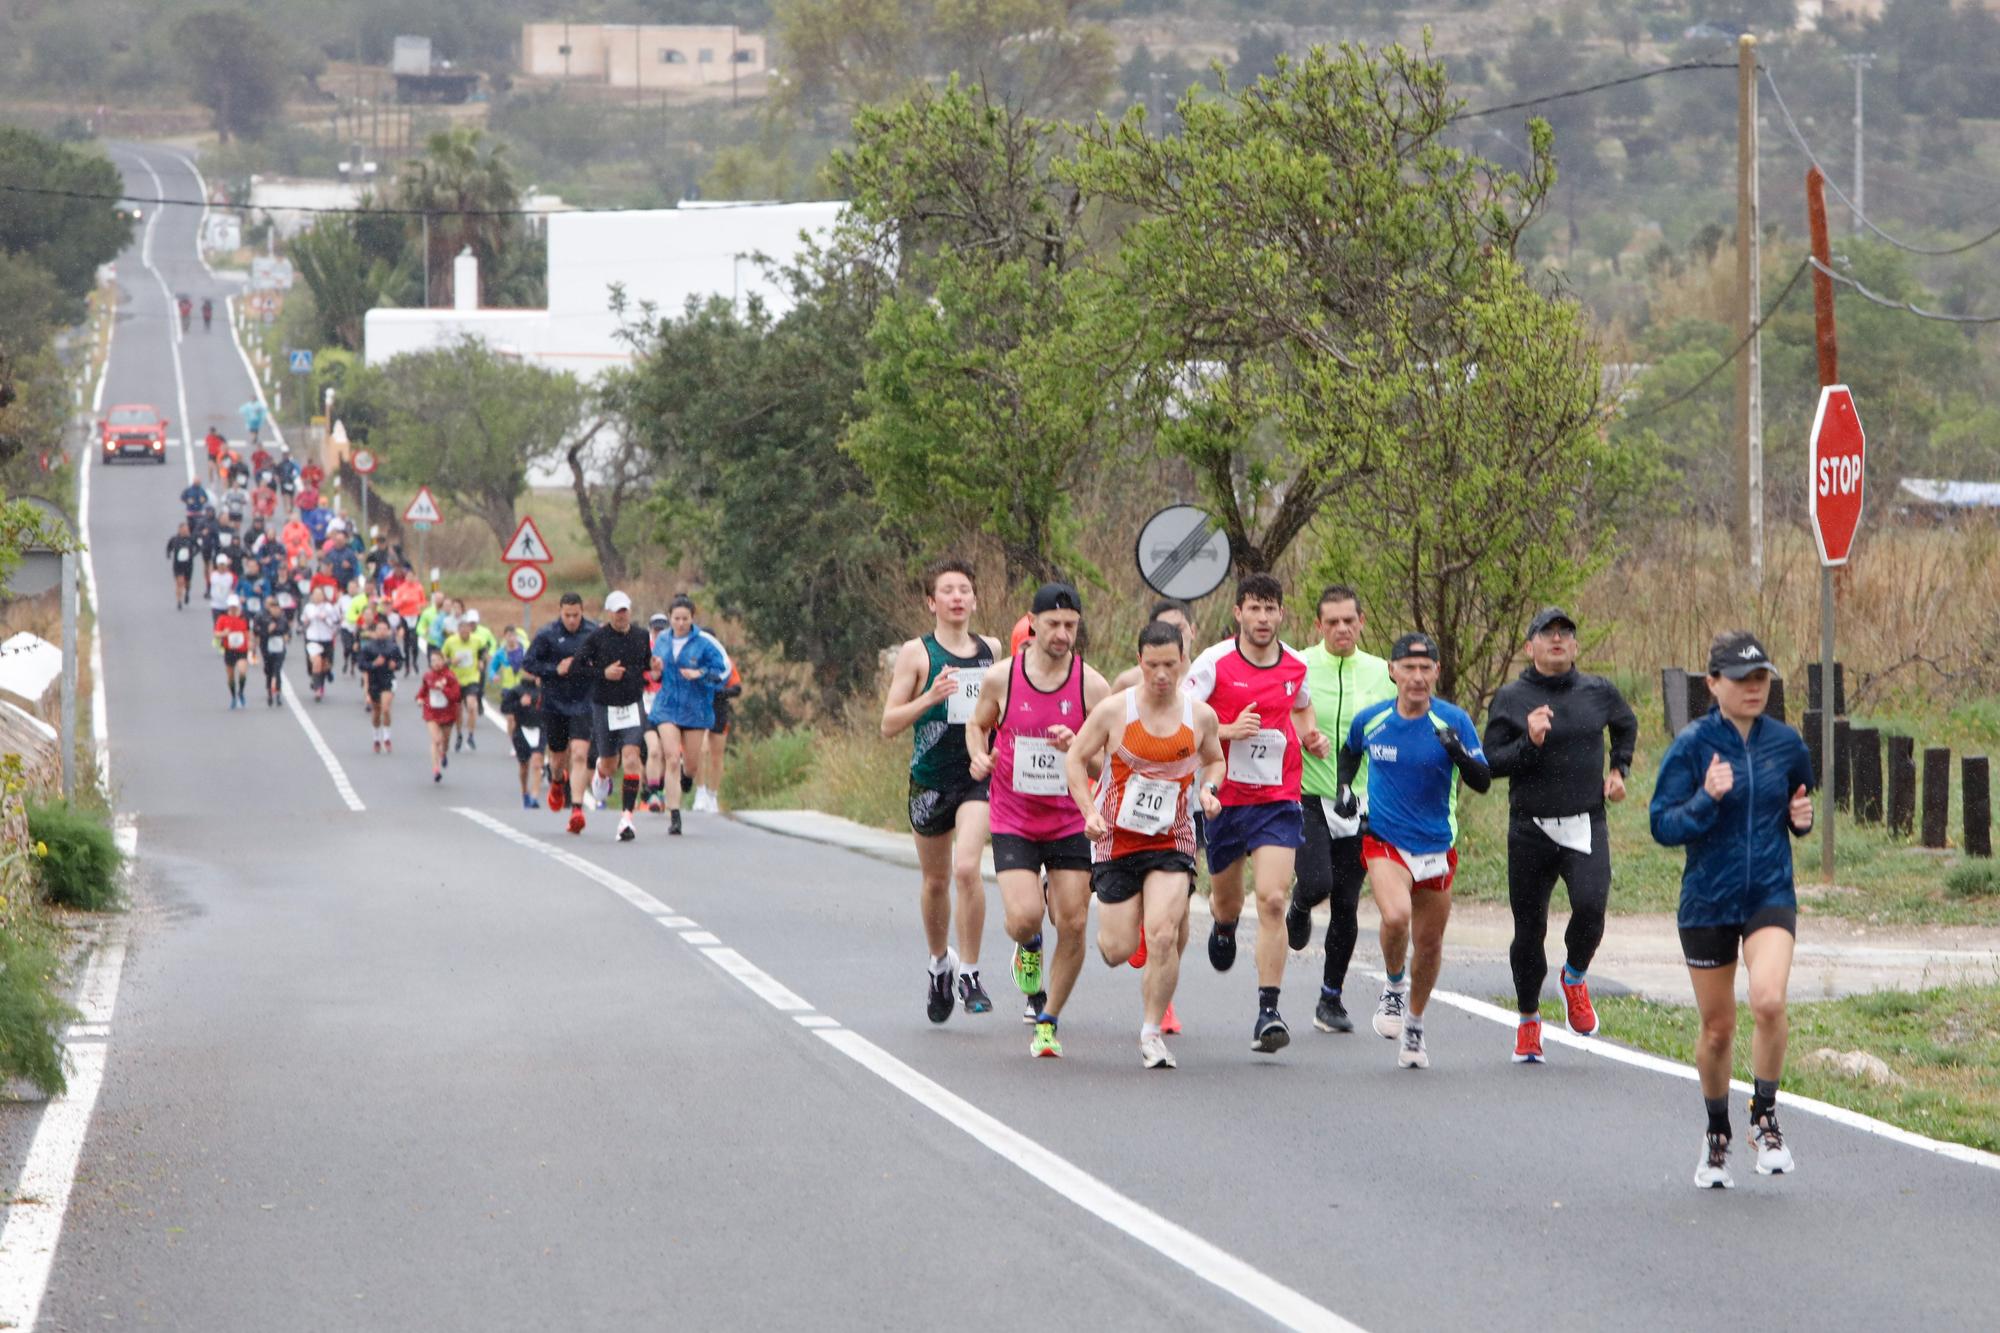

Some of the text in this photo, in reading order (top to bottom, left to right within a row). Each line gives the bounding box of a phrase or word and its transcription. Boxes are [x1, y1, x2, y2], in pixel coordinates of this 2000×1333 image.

[1819, 454, 1861, 497] STOP
[517, 576, 538, 589] 50
[1250, 744, 1267, 759] 72
[1030, 753, 1056, 769] 162
[1136, 792, 1163, 811] 210
